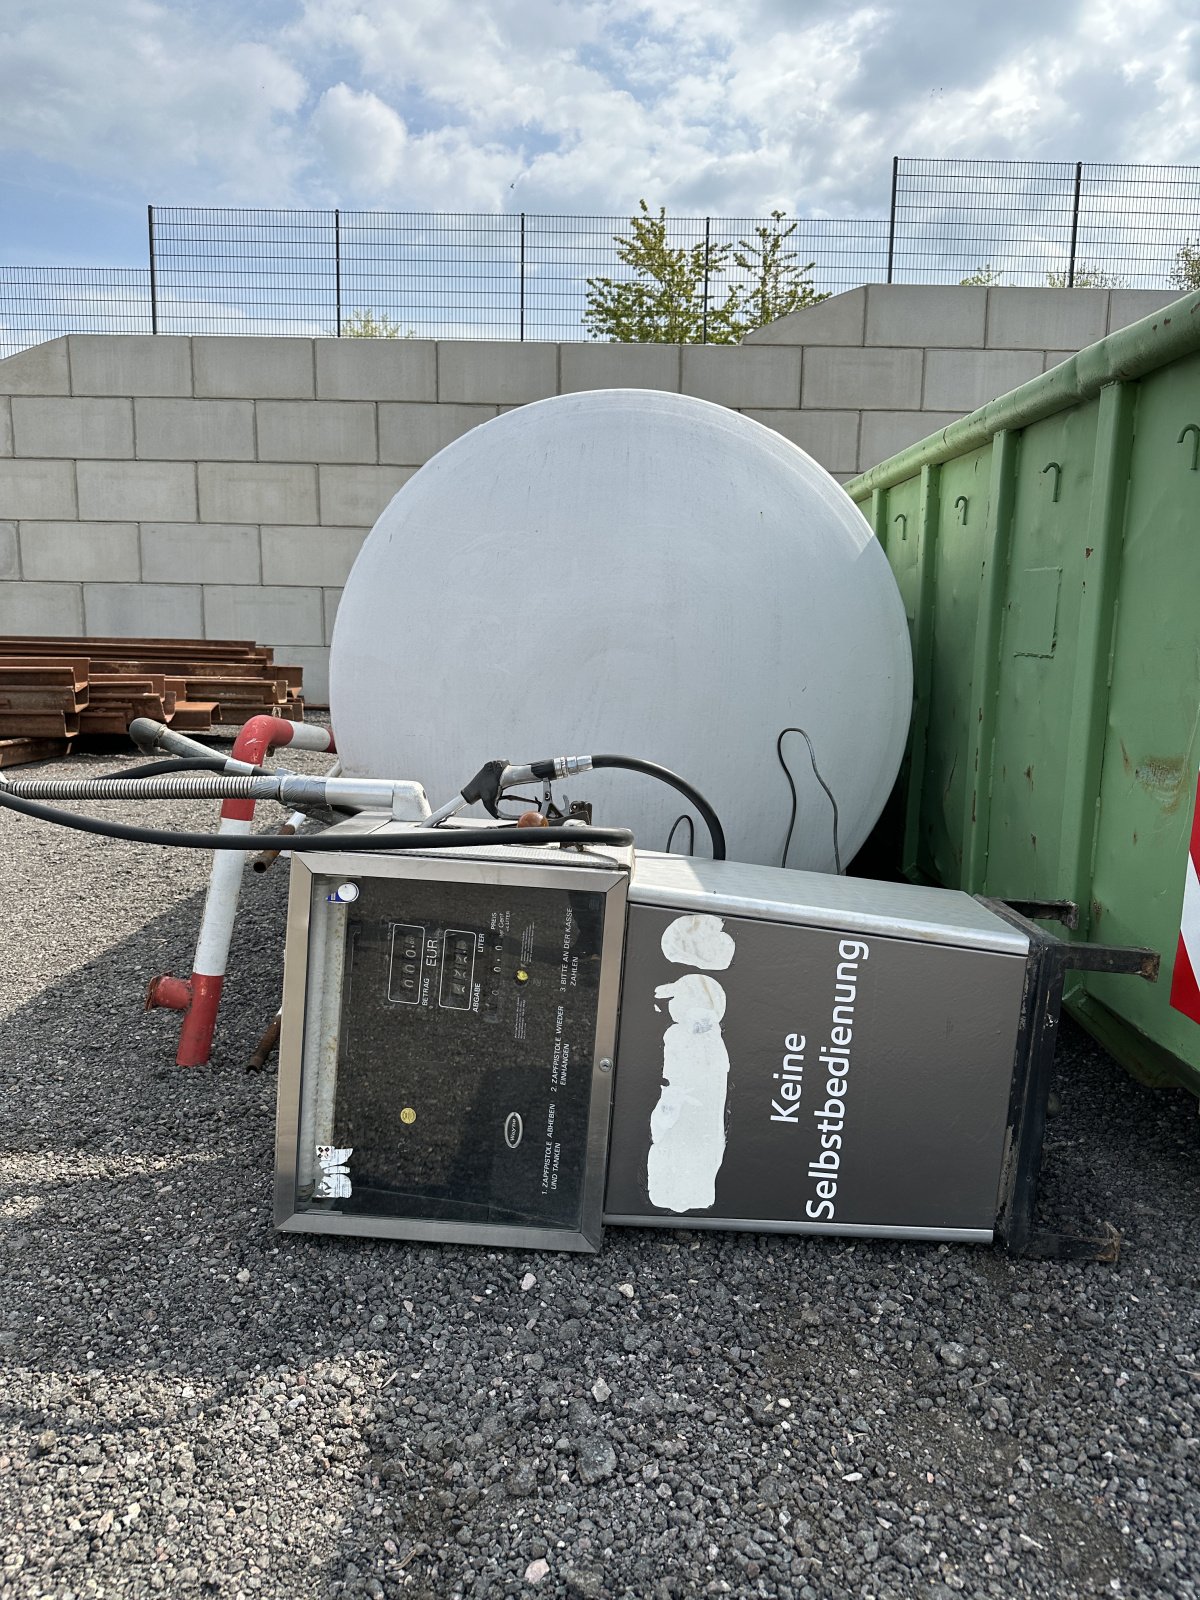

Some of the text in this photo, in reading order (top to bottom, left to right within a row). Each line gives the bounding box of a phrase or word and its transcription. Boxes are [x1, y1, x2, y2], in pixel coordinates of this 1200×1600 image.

[490, 912, 498, 930] PREIS
[565, 908, 573, 933] KASSE
[426, 939, 438, 967] EUR
[477, 933, 485, 953] LITER
[562, 950, 570, 963] AN
[560, 963, 568, 985] BITTE
[570, 956, 578, 987] ZAHLEN
[422, 978, 430, 1006] BETRAG
[472, 983, 481, 1013] ABGABE
[556, 1005, 564, 1034] WIEDER
[552, 1037, 562, 1084] ZAPFPISTOLE
[770, 1032, 806, 1124] Keine
[806, 939, 870, 1220] Selbstbedienung
[547, 1103, 556, 1138] ABHEBEN
[542, 1141, 553, 1188] ZAPFPISTOLE
[553, 1142, 561, 1172] TANKEN
